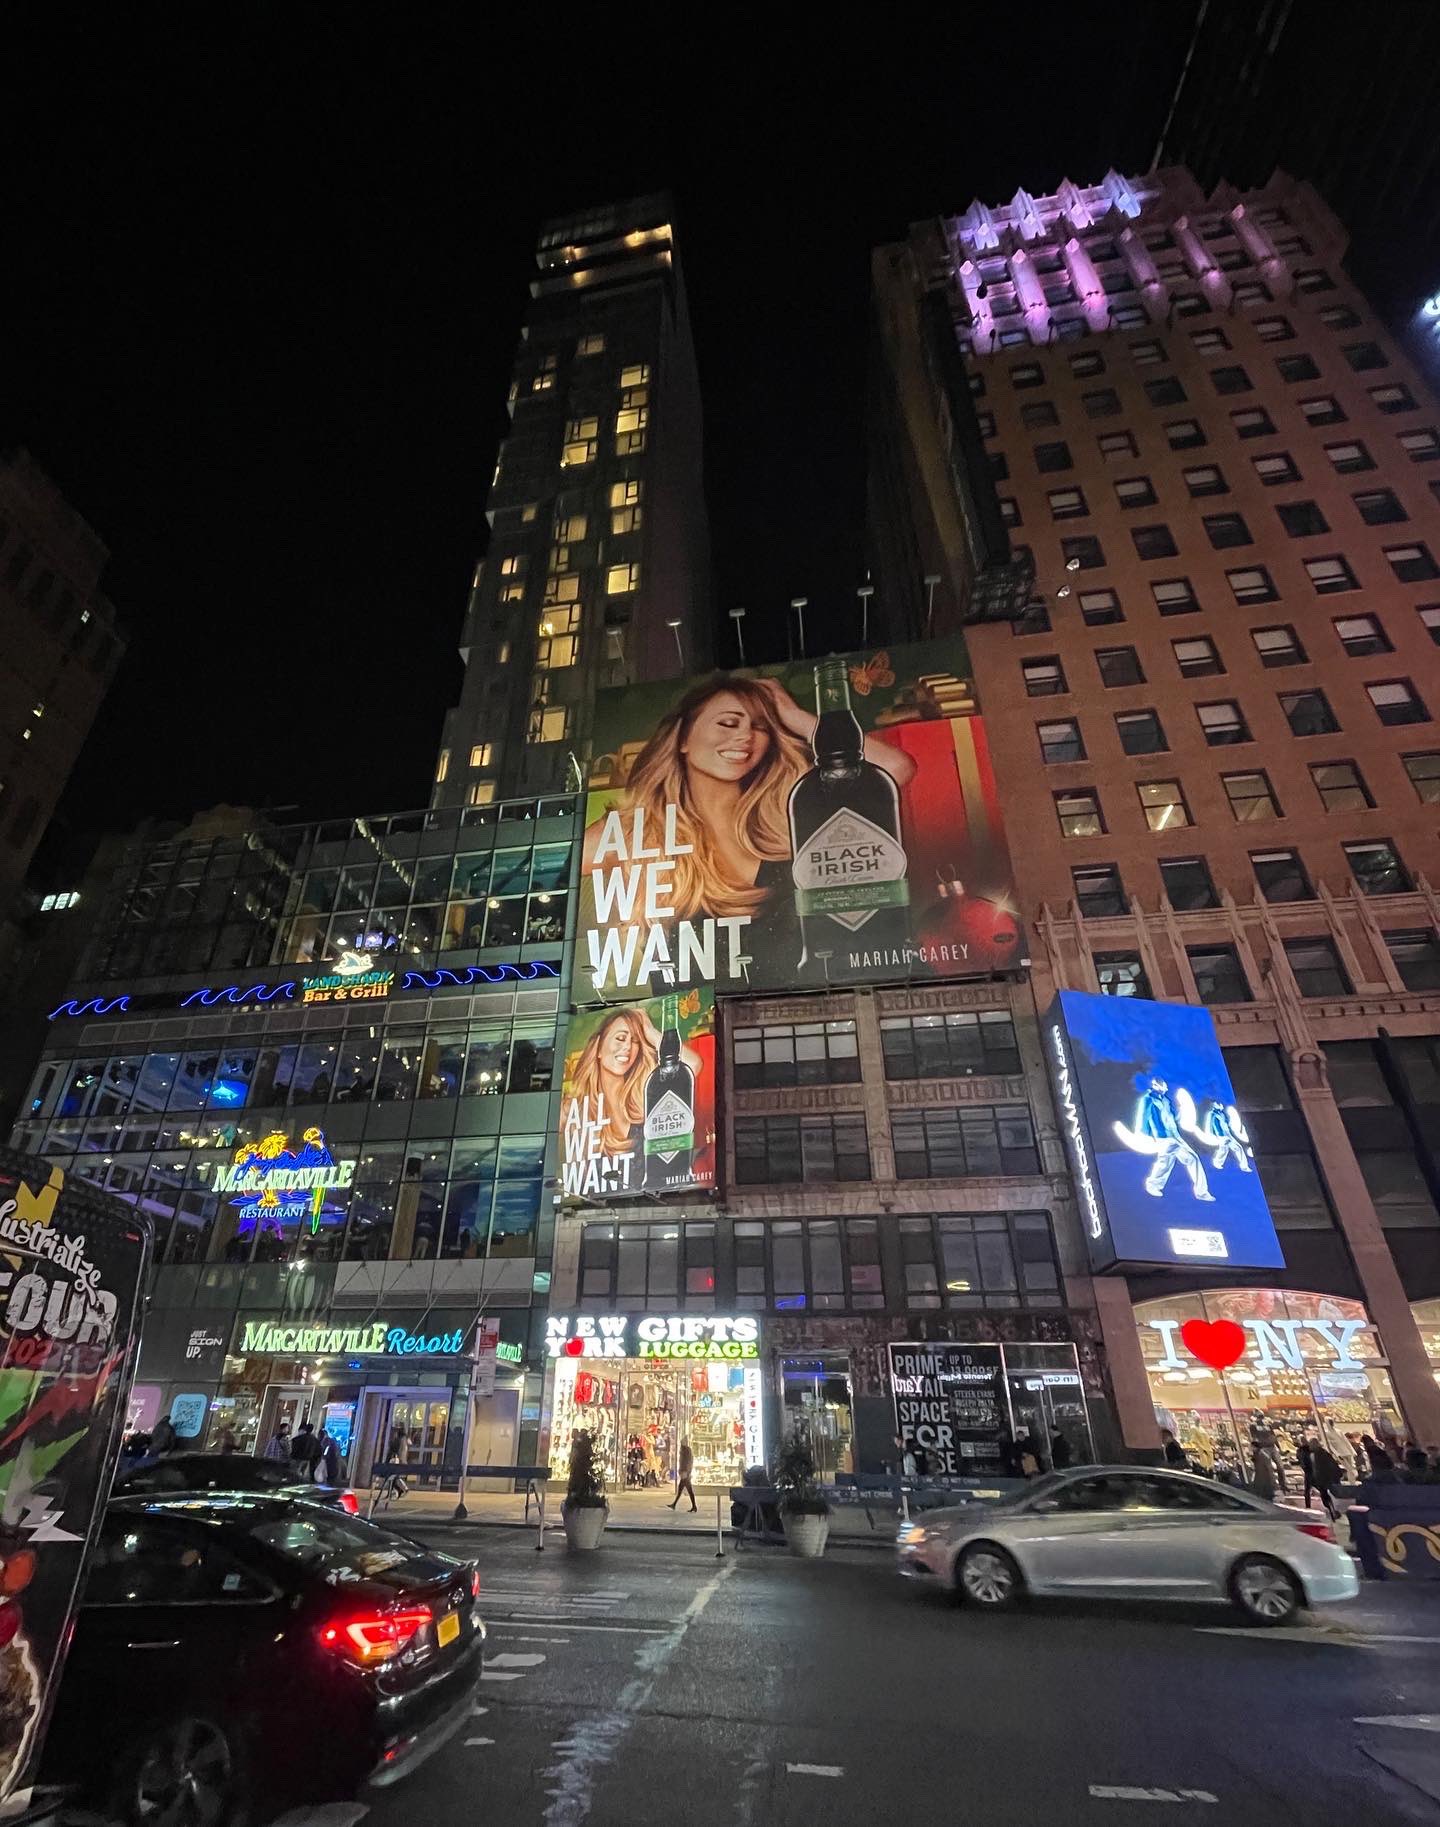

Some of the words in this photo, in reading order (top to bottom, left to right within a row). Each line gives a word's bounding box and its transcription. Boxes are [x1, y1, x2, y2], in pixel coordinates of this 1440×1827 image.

[593, 803, 693, 864] ALL
[810, 844, 886, 863] BLACK
[818, 859, 880, 876] IRISH
[592, 860, 675, 924] WE
[587, 915, 752, 989] WANT
[849, 949, 912, 968] MARIAH
[919, 944, 968, 963] CAREY
[303, 990, 332, 1002] Bar
[334, 988, 347, 1000] &
[350, 983, 388, 998] Grill
[565, 1092, 611, 1130] ALL
[652, 1113, 686, 1125] BLACK
[654, 1121, 682, 1132] IRISH
[564, 1125, 604, 1164] WE
[211, 1160, 357, 1192] MARGARITAVILLE
[562, 1152, 635, 1197] WANT
[239, 1206, 305, 1219] RESTAURANT
[240, 1321, 388, 1353] MARGARITAVILLE
[388, 1327, 465, 1355] Resort
[545, 1317, 628, 1337] NEW
[638, 1317, 759, 1342] GIFTS
[639, 1341, 759, 1358] LUGGAGE
[1150, 1320, 1188, 1368] I
[1243, 1320, 1367, 1370] NY
[895, 1355, 943, 1375] PRIME
[949, 1355, 960, 1365] UP
[962, 1355, 972, 1365] TO
[900, 1402, 951, 1422] SPACE
